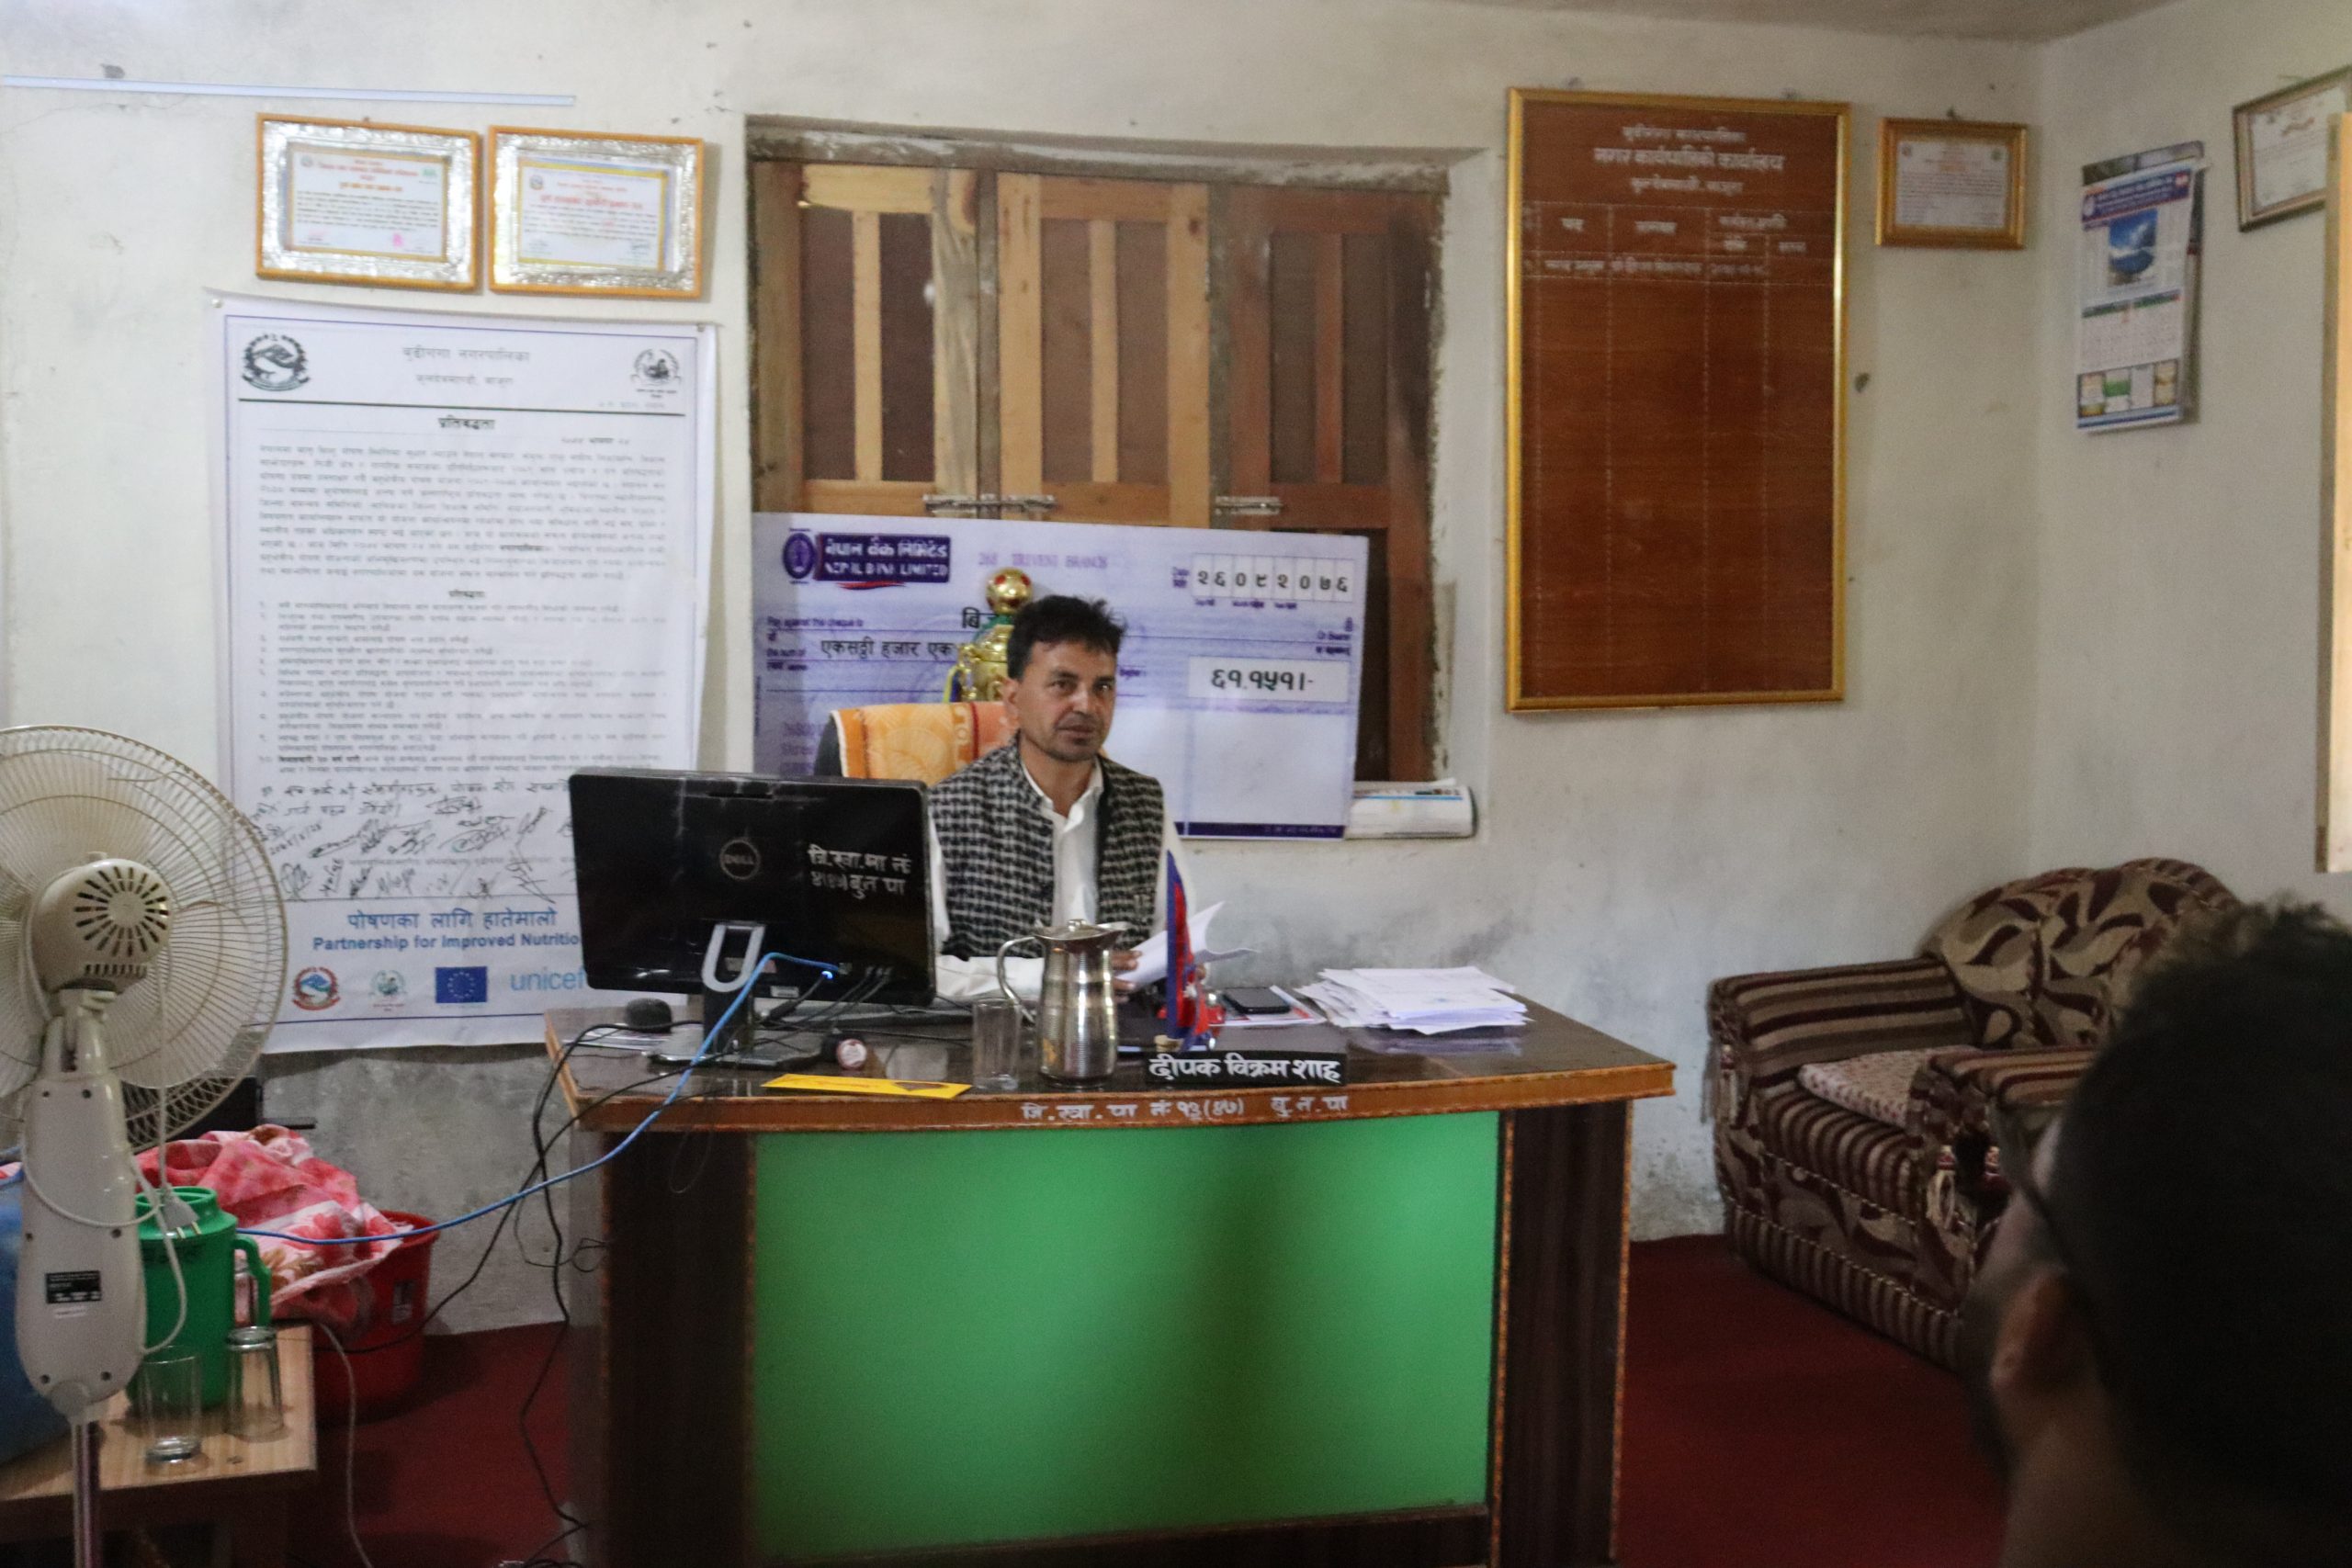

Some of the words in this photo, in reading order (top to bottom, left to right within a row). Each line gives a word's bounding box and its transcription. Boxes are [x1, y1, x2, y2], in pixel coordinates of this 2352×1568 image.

[880, 640, 922, 658] हजार
[347, 910, 419, 930] पोषणका
[430, 908, 474, 928] लागि
[482, 908, 558, 930] हातेमालो
[312, 936, 408, 951] Partnership
[413, 935, 436, 949] for
[442, 934, 515, 950] Improved
[521, 932, 580, 946] Nutritio
[510, 967, 586, 992] unicef
[1149, 1053, 1222, 1081] दीपक
[1225, 1052, 1290, 1079] विक्रम
[1292, 1059, 1342, 1085] शाह
